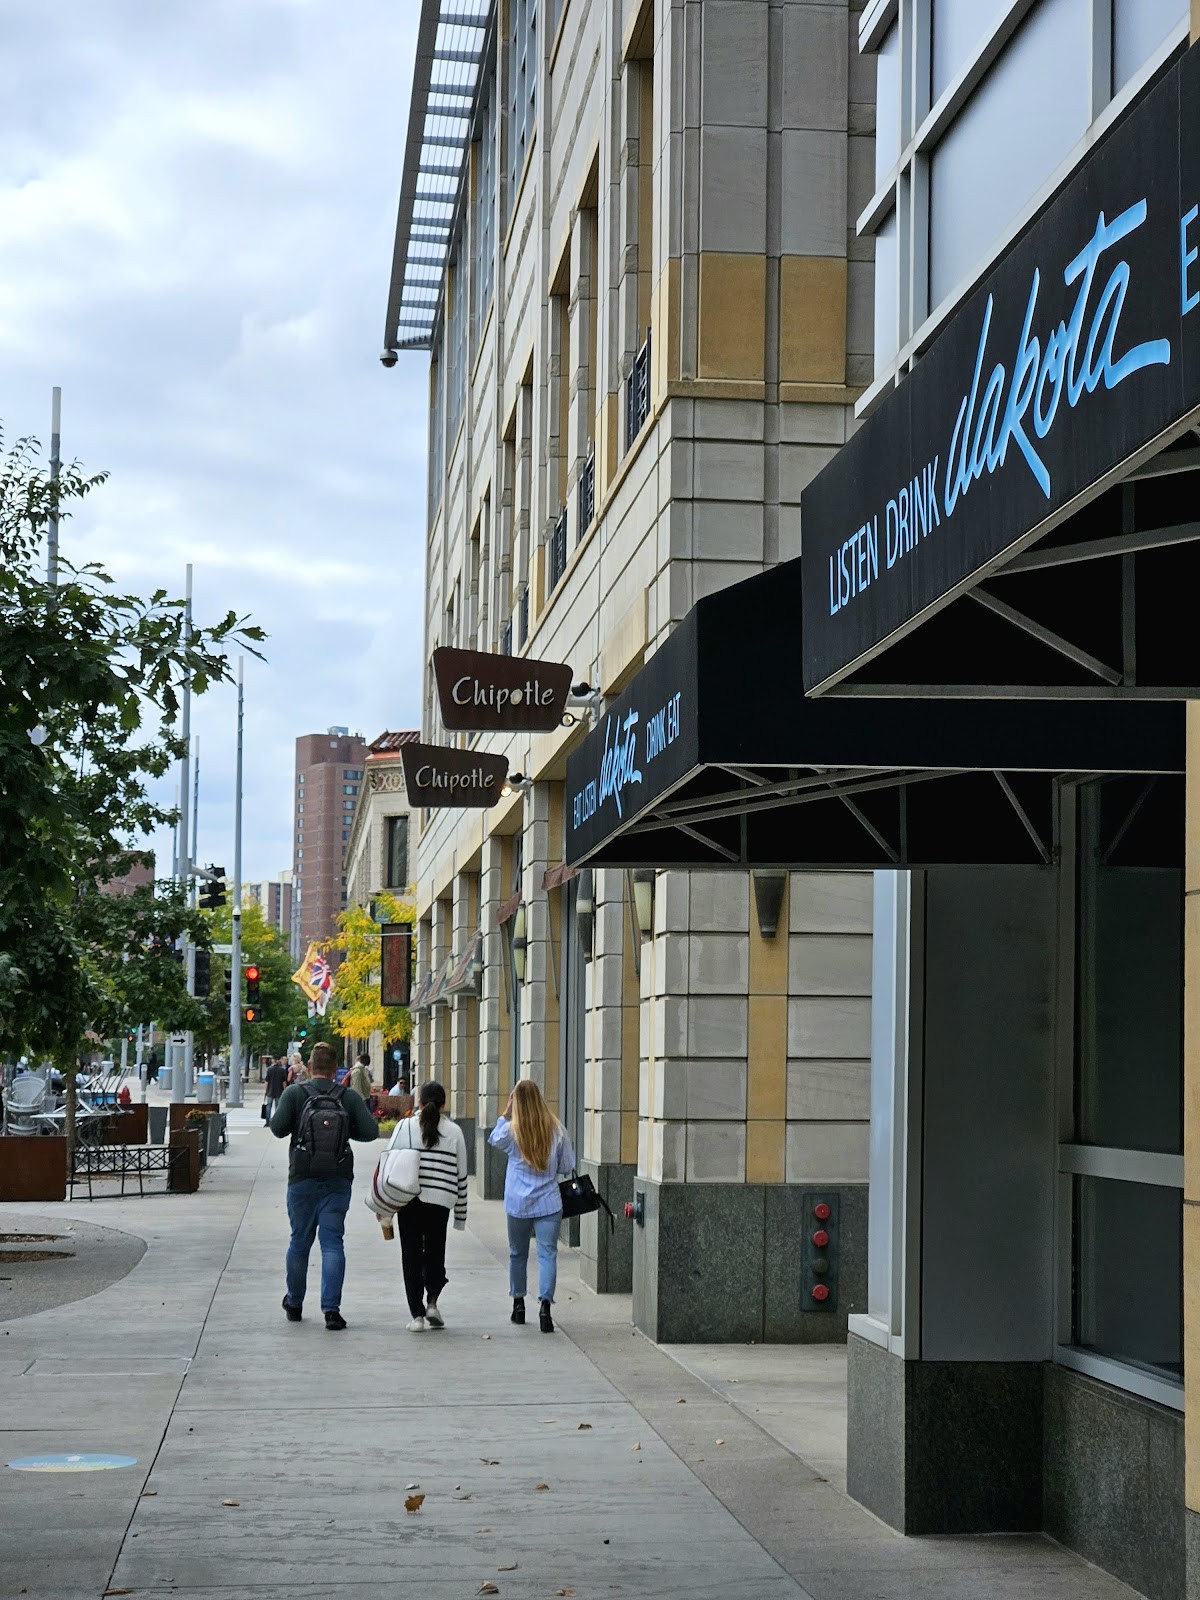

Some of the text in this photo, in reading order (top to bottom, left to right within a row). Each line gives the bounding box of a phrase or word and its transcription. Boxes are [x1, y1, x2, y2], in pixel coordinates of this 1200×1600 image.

[829, 514, 879, 616] LISTEN
[885, 455, 941, 570] DRINK
[944, 198, 1171, 518] dakota
[451, 676, 555, 713] Chipotle
[415, 765, 495, 794] Chipotle
[598, 708, 643, 819] dakota
[646, 706, 667, 764] DRINK
[667, 691, 681, 745] EAT
